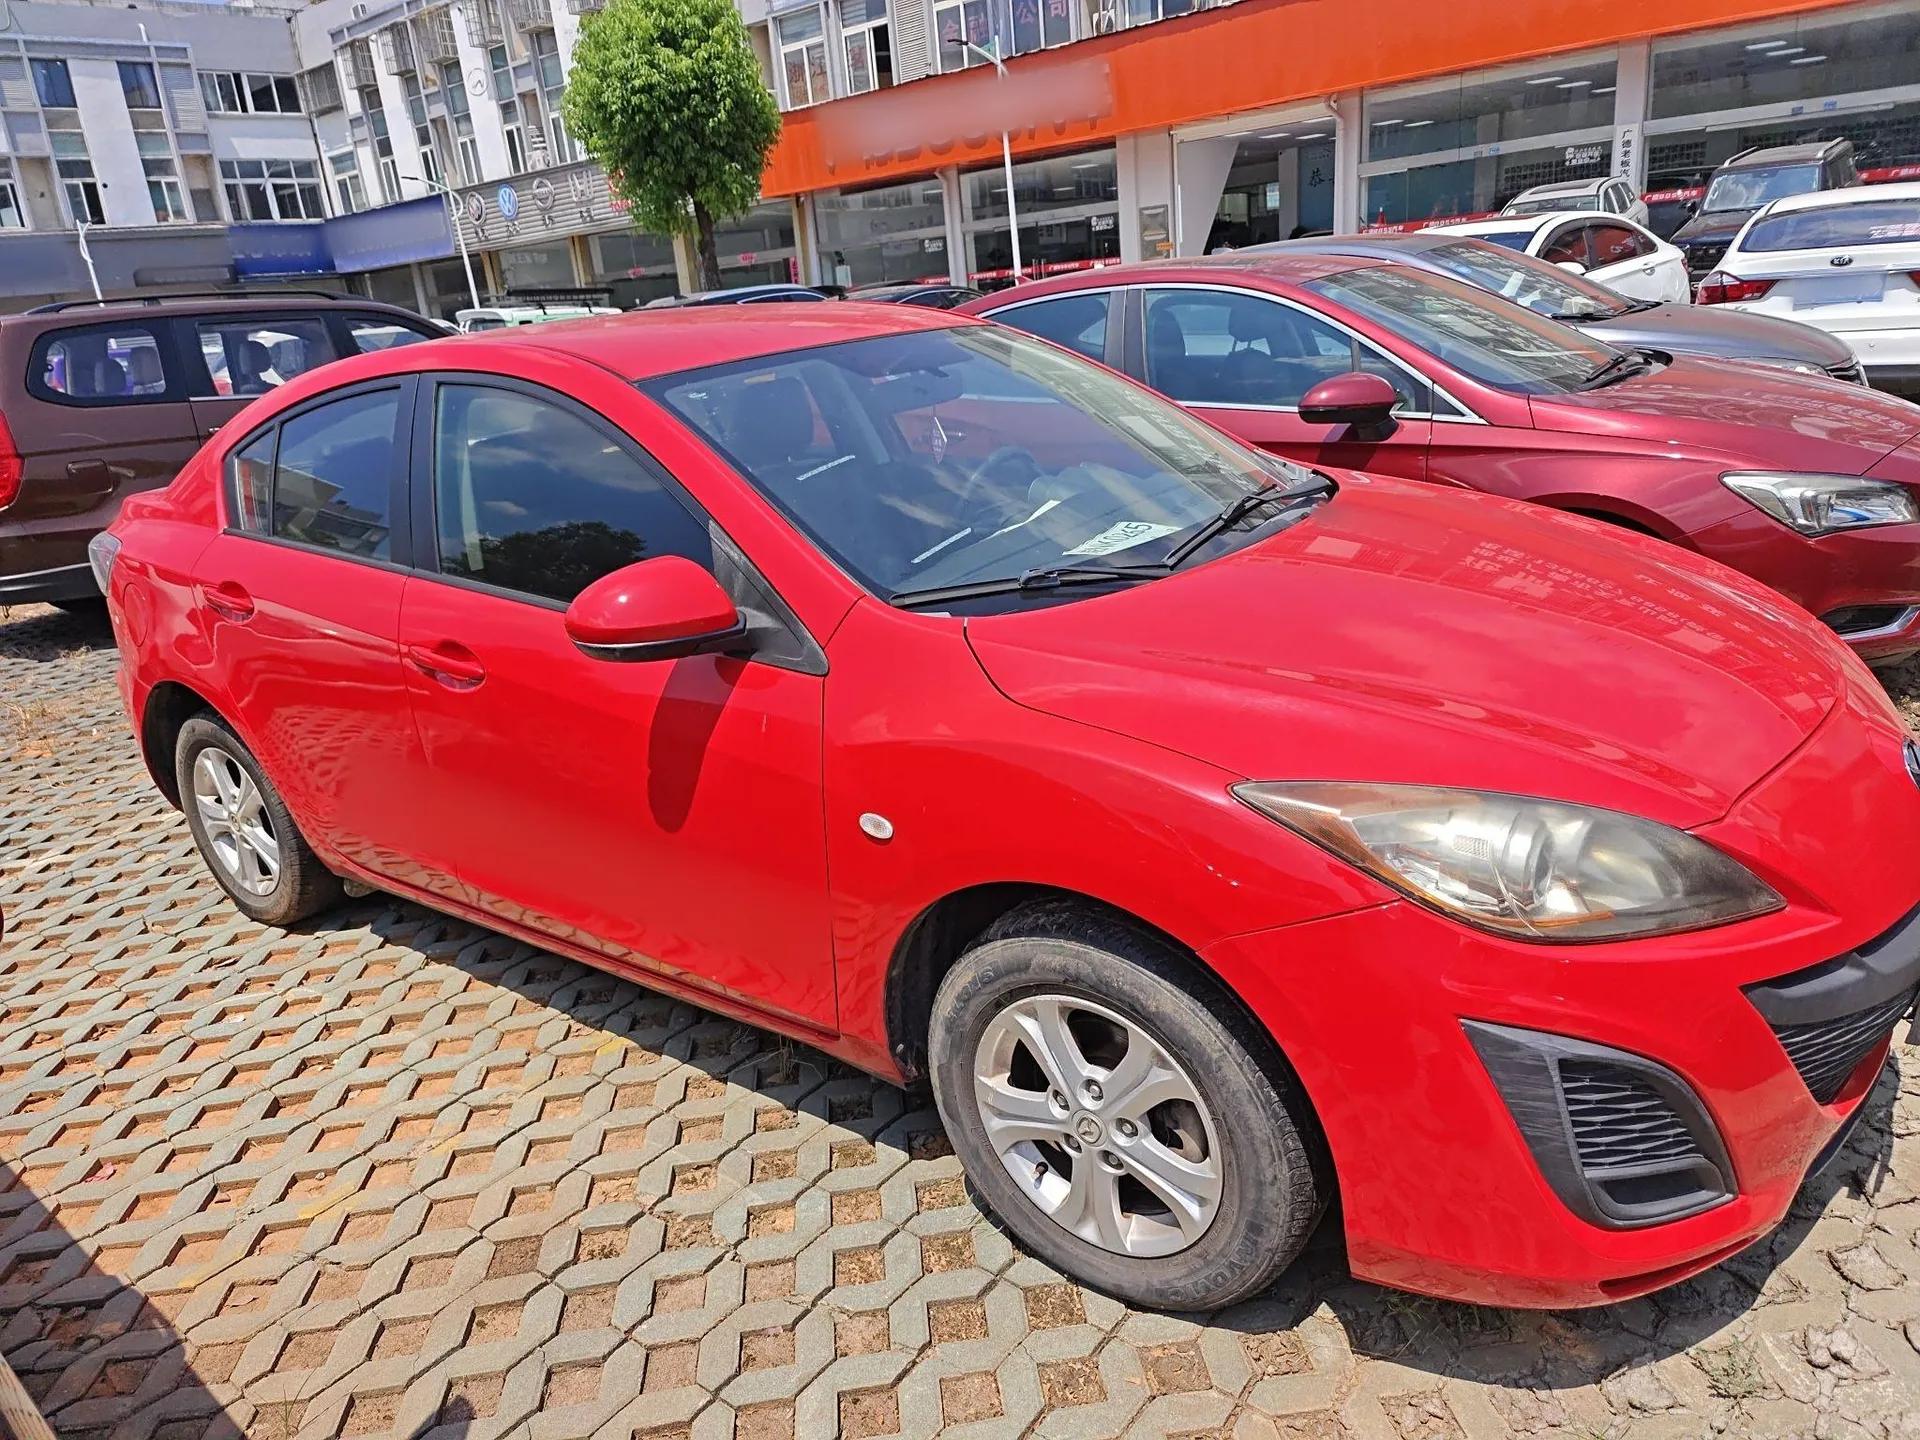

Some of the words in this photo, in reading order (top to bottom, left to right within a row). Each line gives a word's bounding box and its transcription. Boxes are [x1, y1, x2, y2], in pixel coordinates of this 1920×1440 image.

[1620, 129, 1632, 180] 广德老板汽
